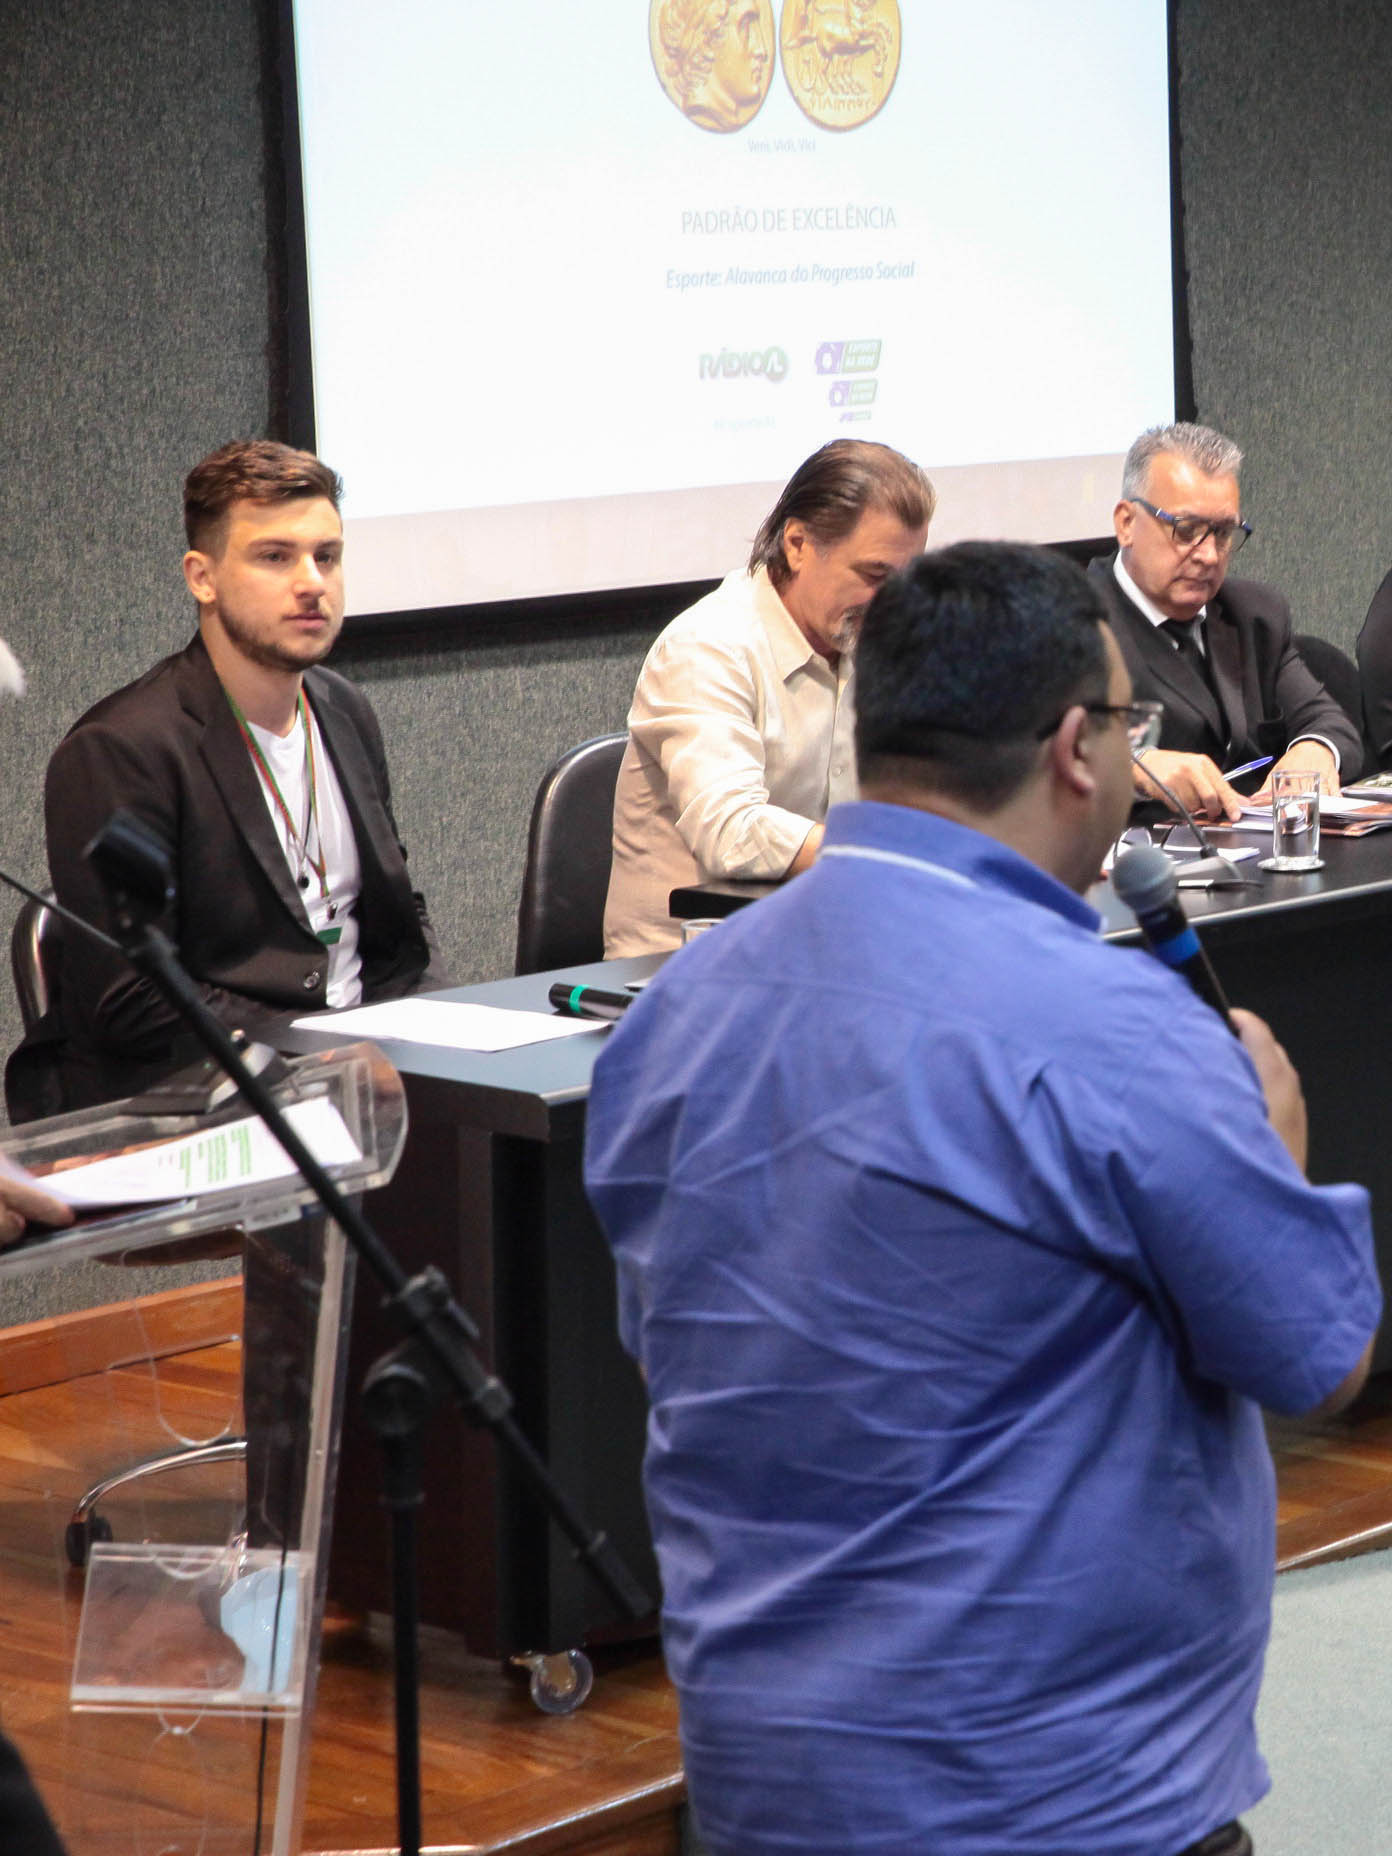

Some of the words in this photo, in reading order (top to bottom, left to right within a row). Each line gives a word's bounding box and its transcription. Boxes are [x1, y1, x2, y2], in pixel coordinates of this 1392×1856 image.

[681, 205, 758, 234] PADRÃO
[763, 208, 787, 232] DE
[792, 202, 898, 231] EXCELÊNCIA
[666, 269, 722, 292] Esporte:
[725, 265, 787, 286] Alavanca
[811, 262, 873, 286] Progresso
[876, 260, 916, 280] Social
